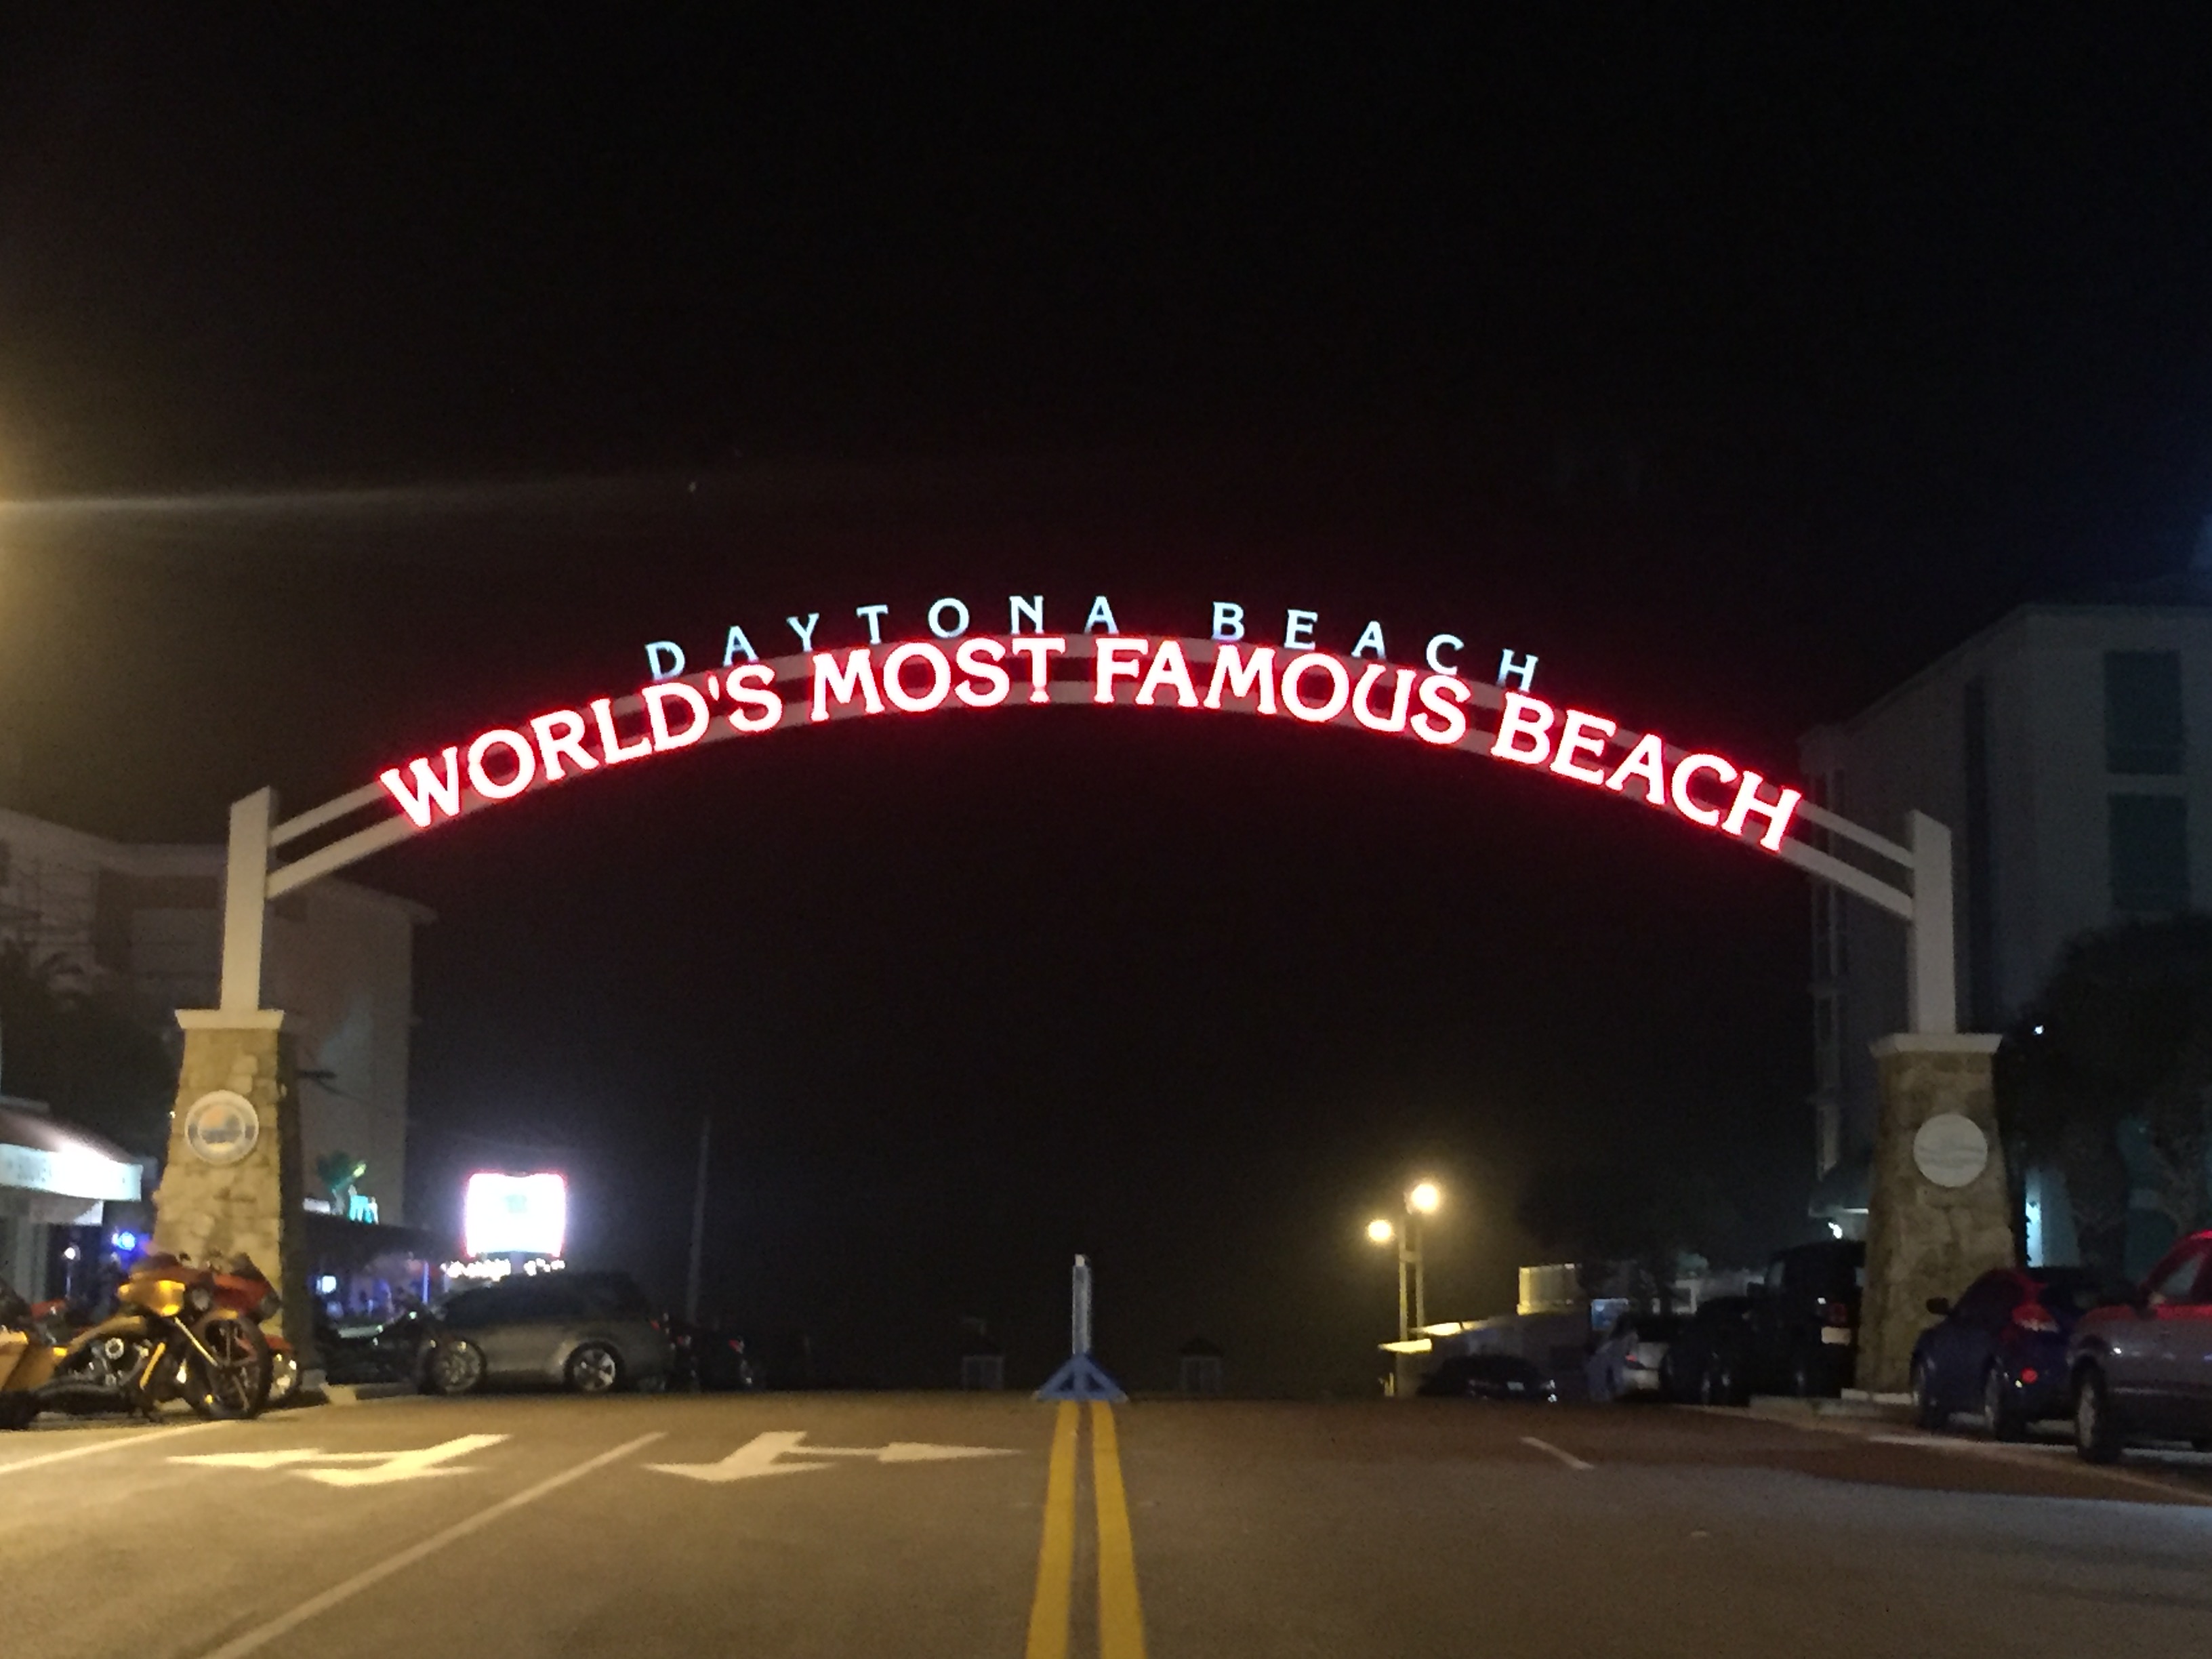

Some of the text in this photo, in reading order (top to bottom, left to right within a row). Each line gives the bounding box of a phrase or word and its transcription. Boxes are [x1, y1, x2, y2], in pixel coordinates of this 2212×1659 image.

[645, 596, 1538, 692] DAYTONA BEACH
[380, 638, 1802, 852] WORLD'S MOST FAMOUS BEACH
